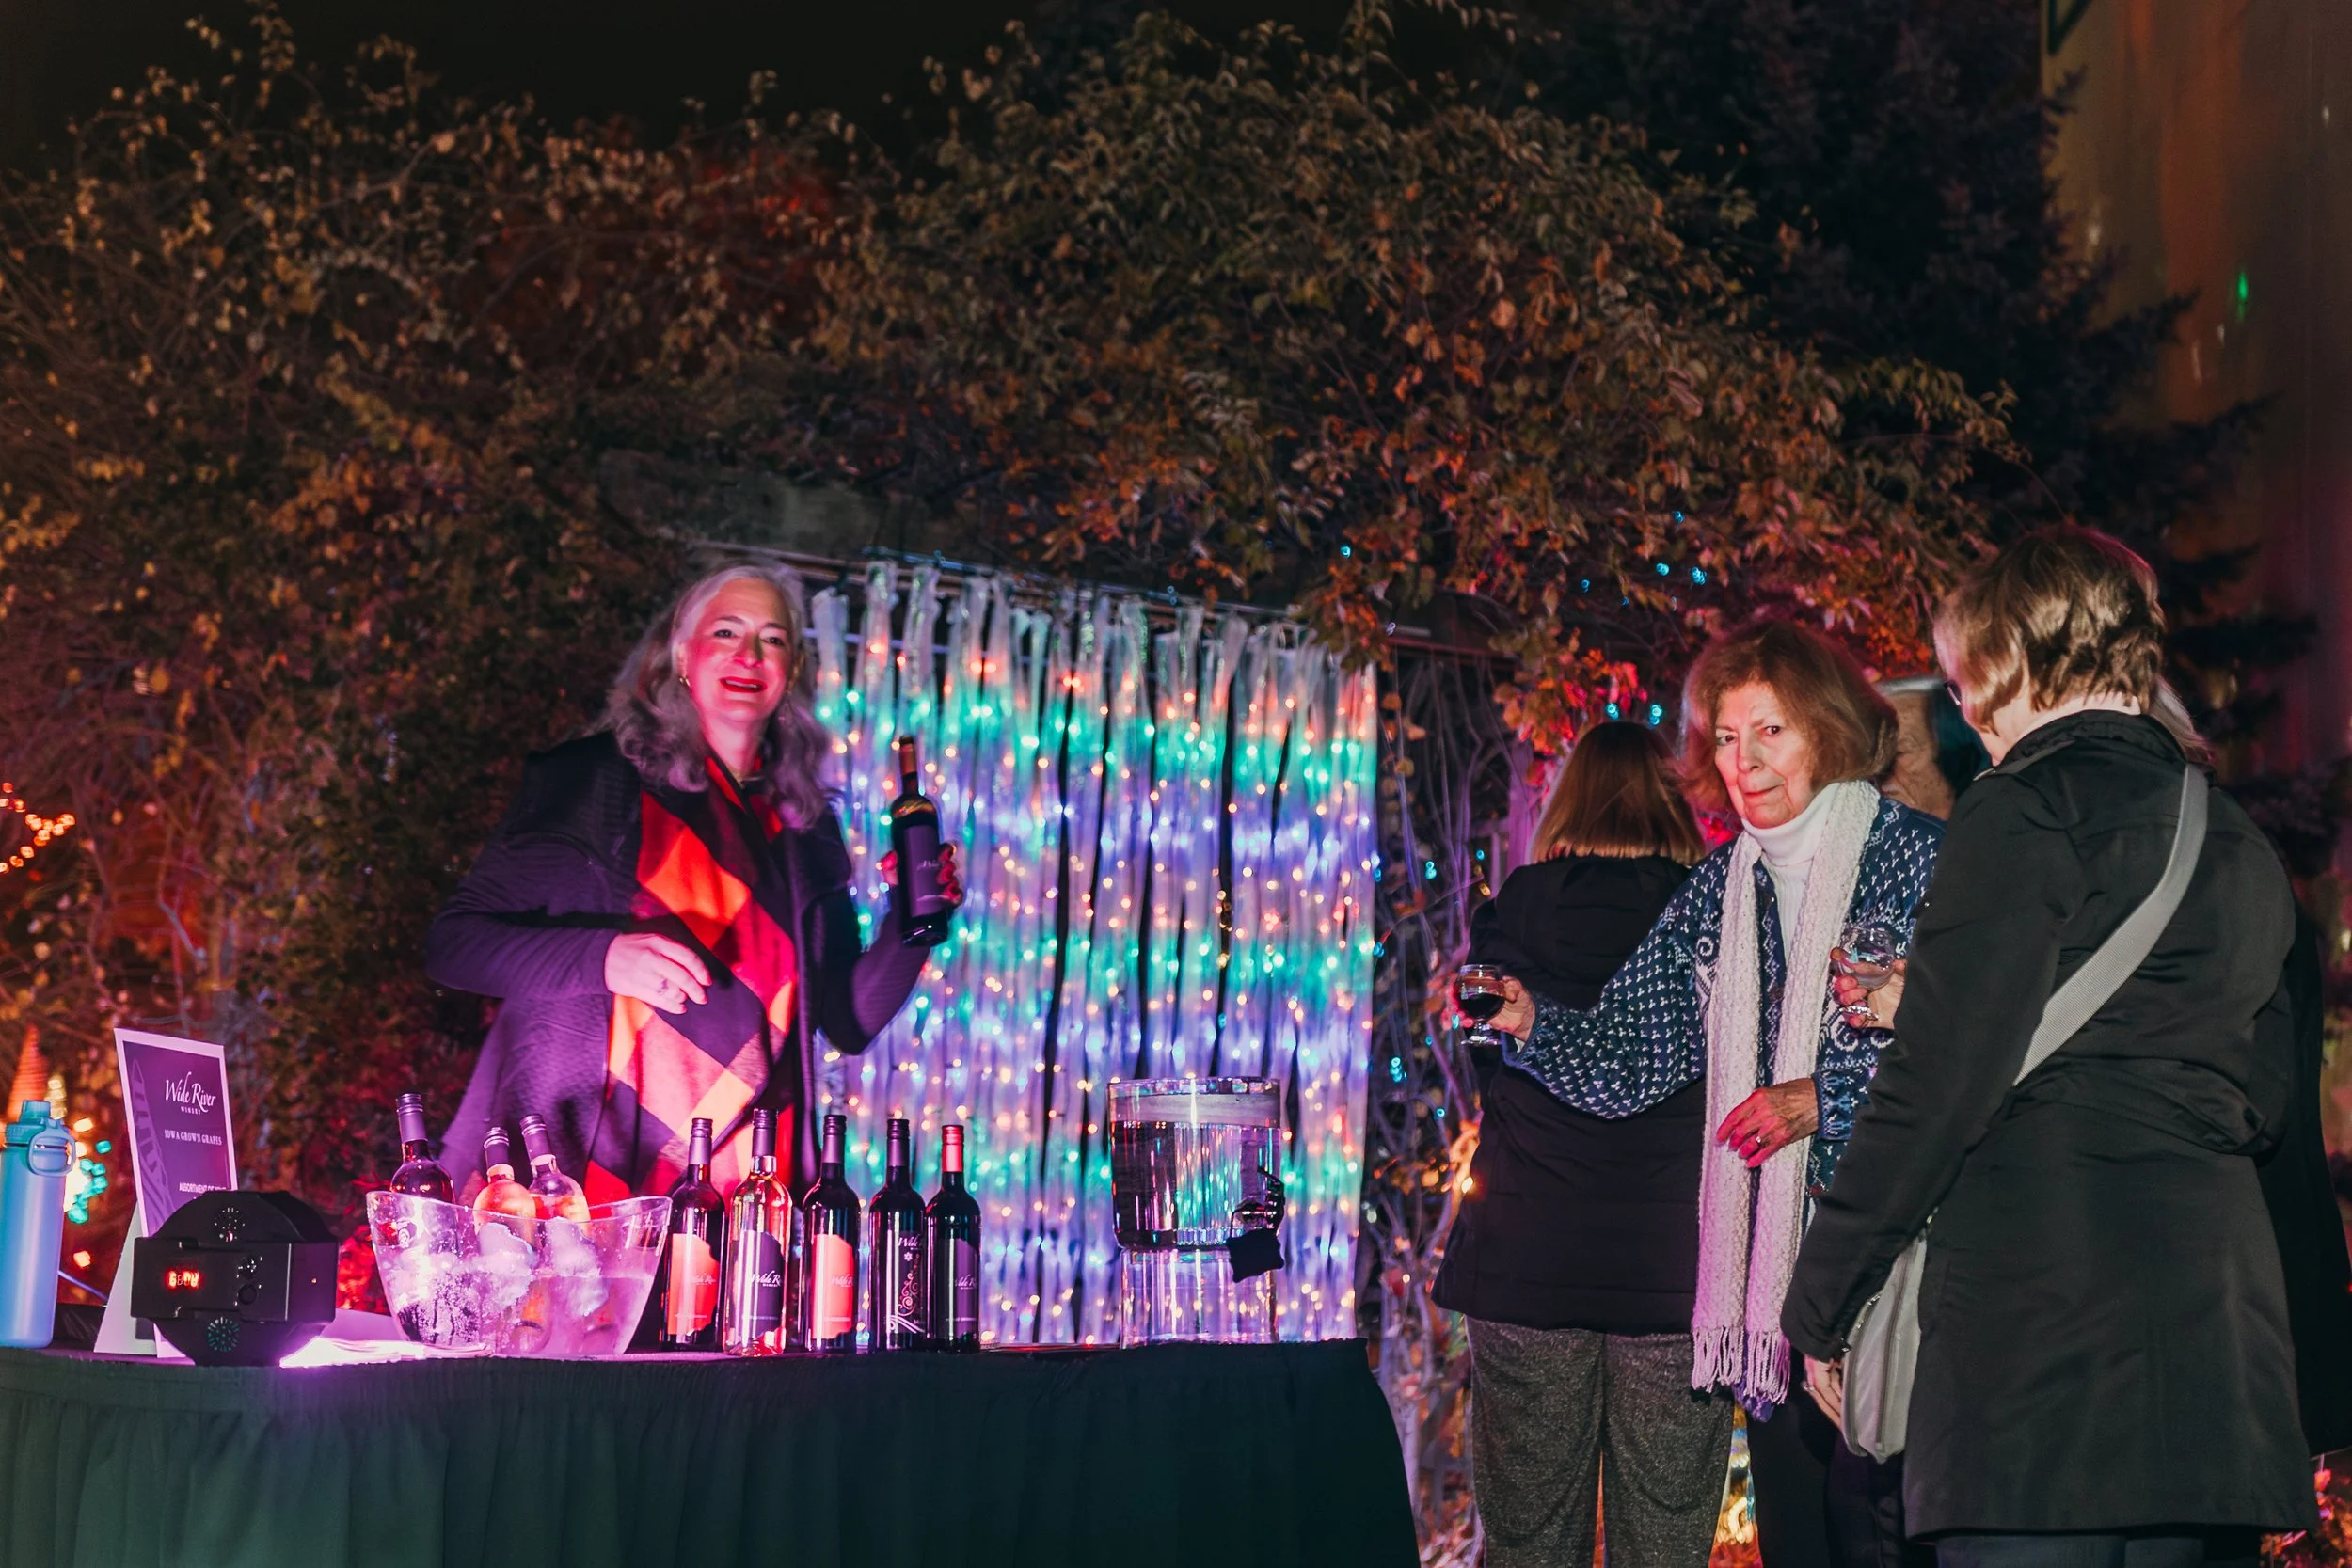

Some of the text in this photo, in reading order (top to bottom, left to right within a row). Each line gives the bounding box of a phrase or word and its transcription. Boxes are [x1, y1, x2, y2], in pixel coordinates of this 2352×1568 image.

[165, 1071, 216, 1113] Wide River
[164, 1129, 223, 1146] IOWA GROWN GRAPES
